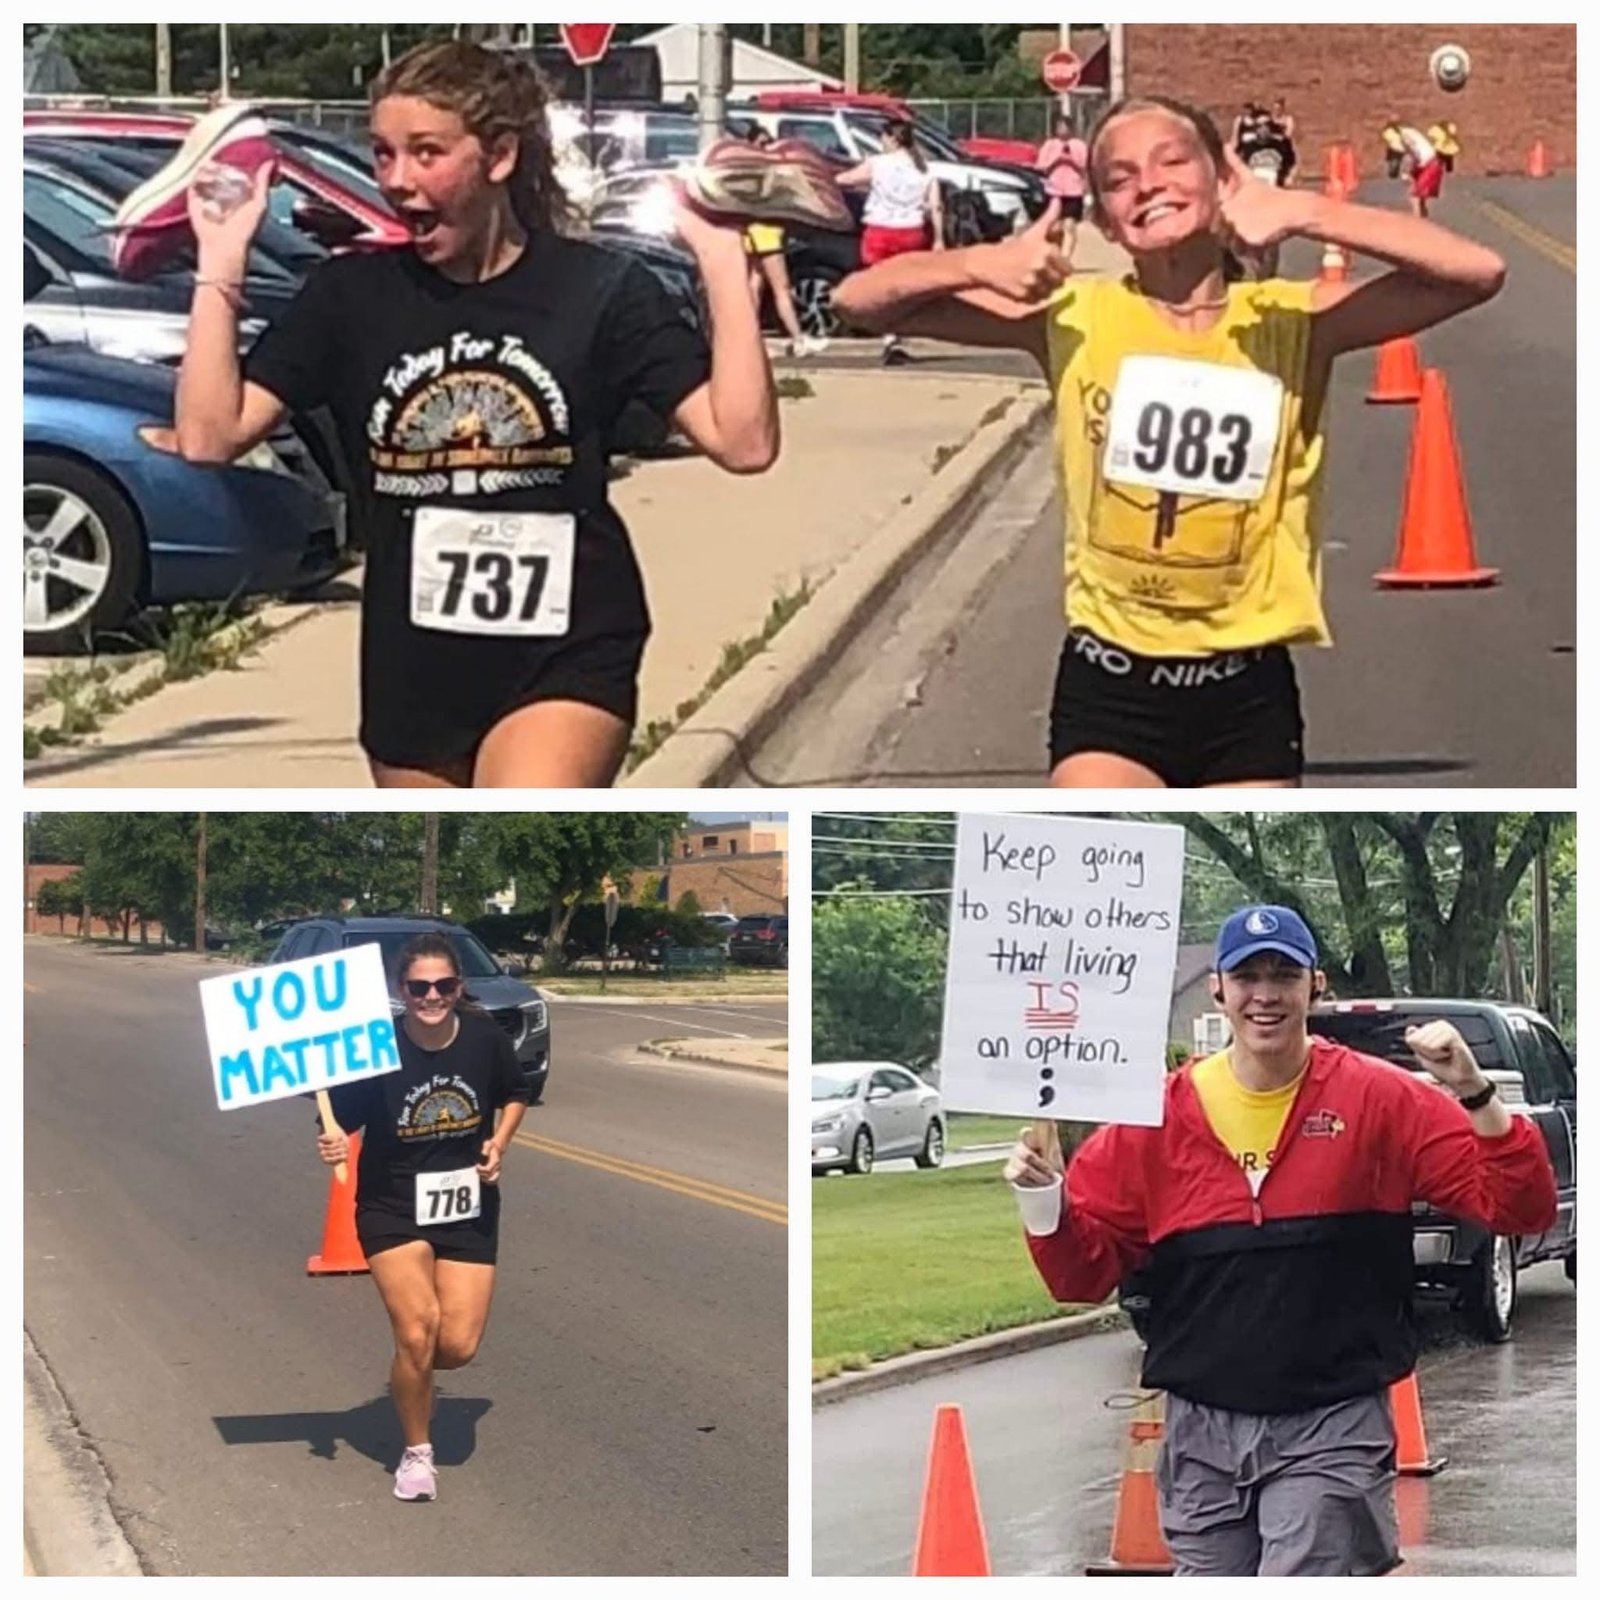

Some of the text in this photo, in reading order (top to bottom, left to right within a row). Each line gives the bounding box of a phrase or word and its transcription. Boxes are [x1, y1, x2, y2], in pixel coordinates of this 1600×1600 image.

[383, 346, 445, 397] Today
[451, 331, 494, 362] For
[497, 334, 569, 436] Tomorrow
[1133, 401, 1252, 485] 983
[437, 552, 550, 621] 737
[983, 832, 1144, 888] Keep going
[958, 888, 1171, 930] to show others
[232, 958, 346, 1031] YOU
[988, 938, 1137, 995] that living
[1026, 980, 1080, 1017] IS
[219, 1018, 398, 1101] MATTER
[977, 1033, 1127, 1064] an option.
[432, 1073, 450, 1088] For
[426, 1186, 471, 1218] 778
